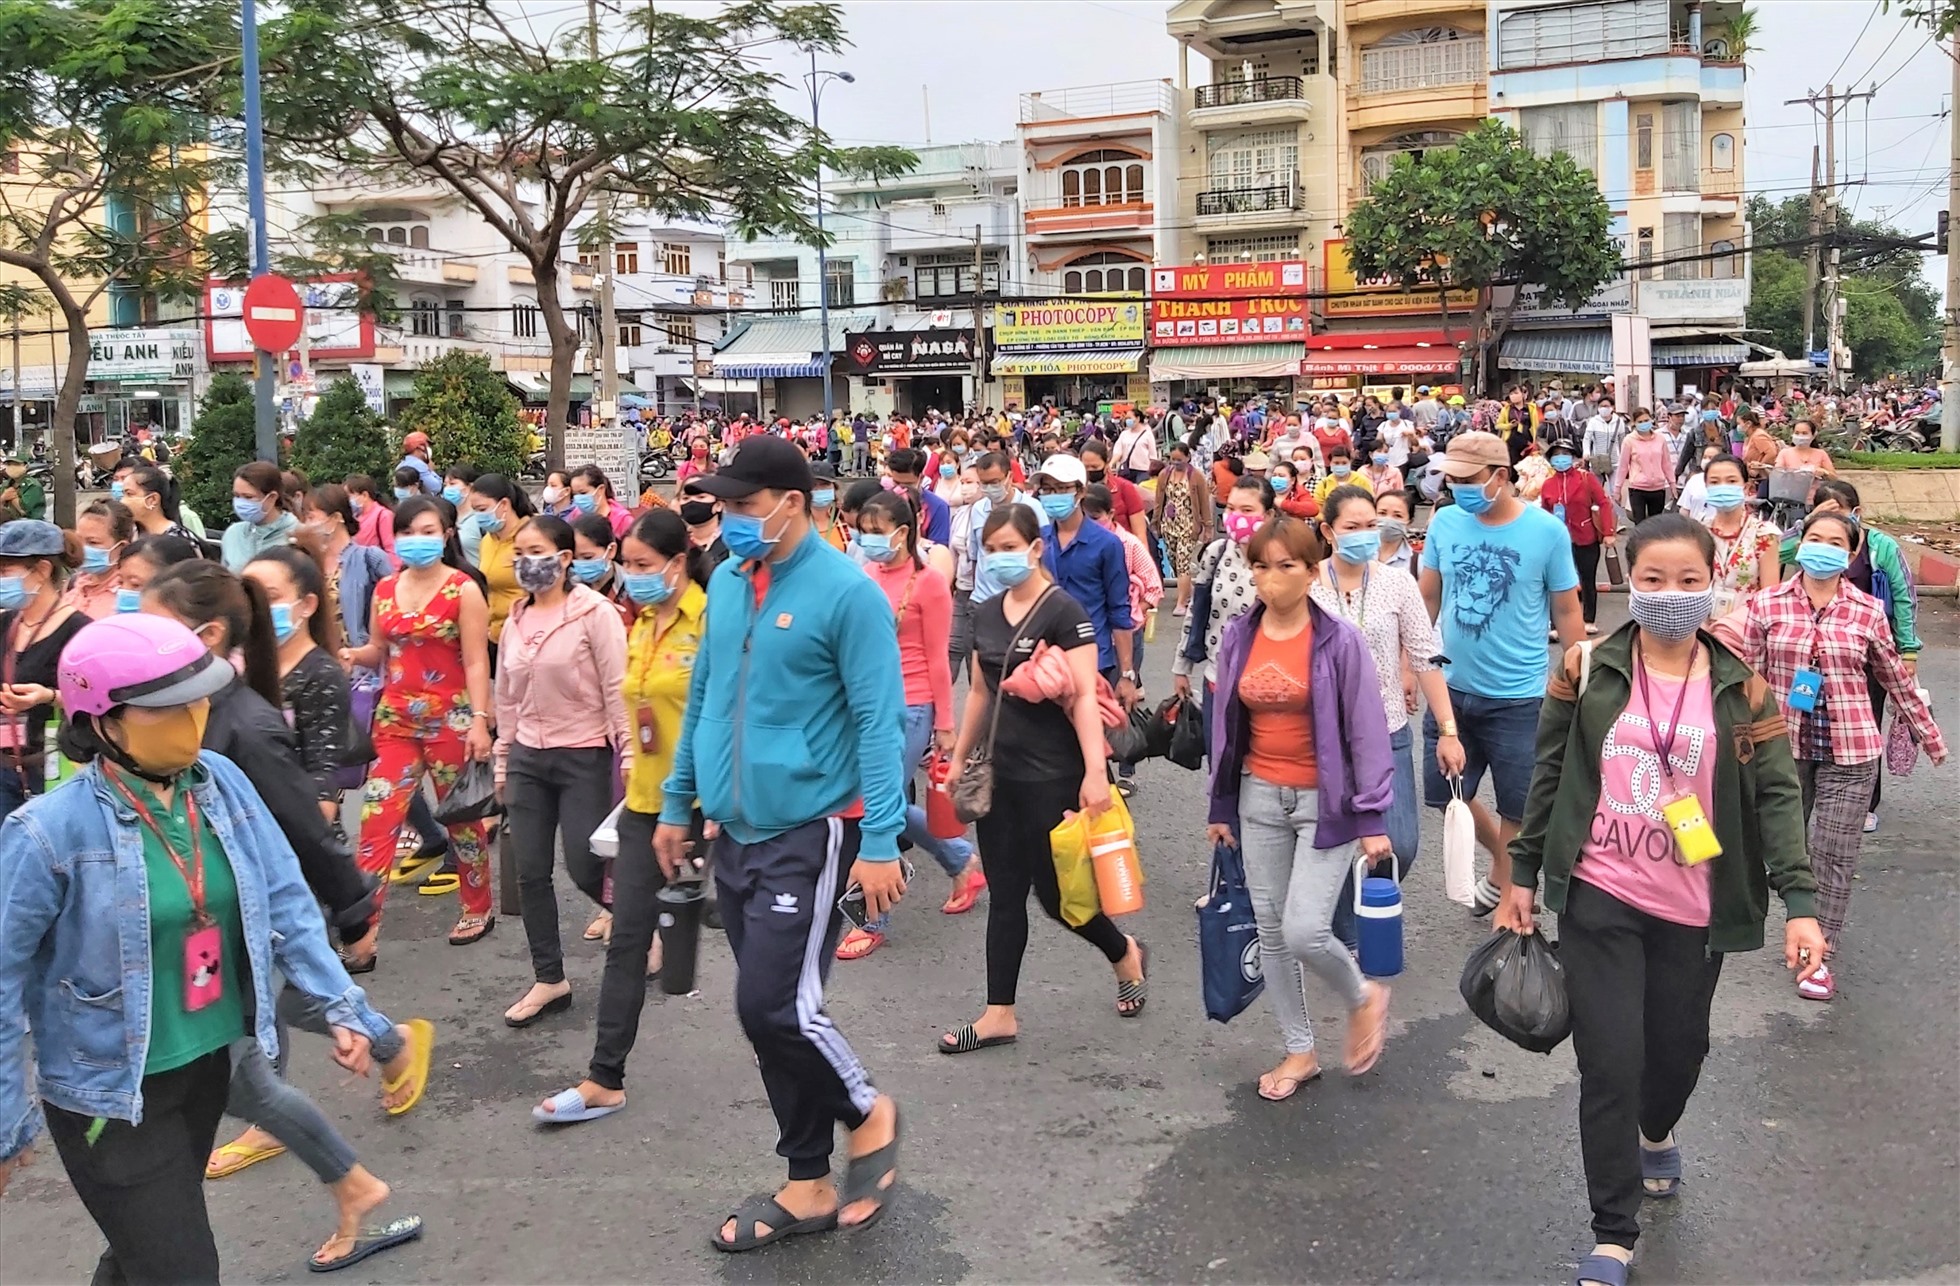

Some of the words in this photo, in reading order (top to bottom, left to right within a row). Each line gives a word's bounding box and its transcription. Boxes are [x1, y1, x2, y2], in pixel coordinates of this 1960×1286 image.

[1182, 268, 1210, 291] MỸ
[1224, 264, 1274, 289] PHẨM
[1156, 300, 1232, 318] THANH
[1245, 287, 1302, 314] TRÚC
[1020, 307, 1117, 326] PHOTOCOPY
[124, 343, 160, 361] ANH
[175, 362, 195, 377] ANH
[1067, 362, 1126, 372] PHOTOCOPY
